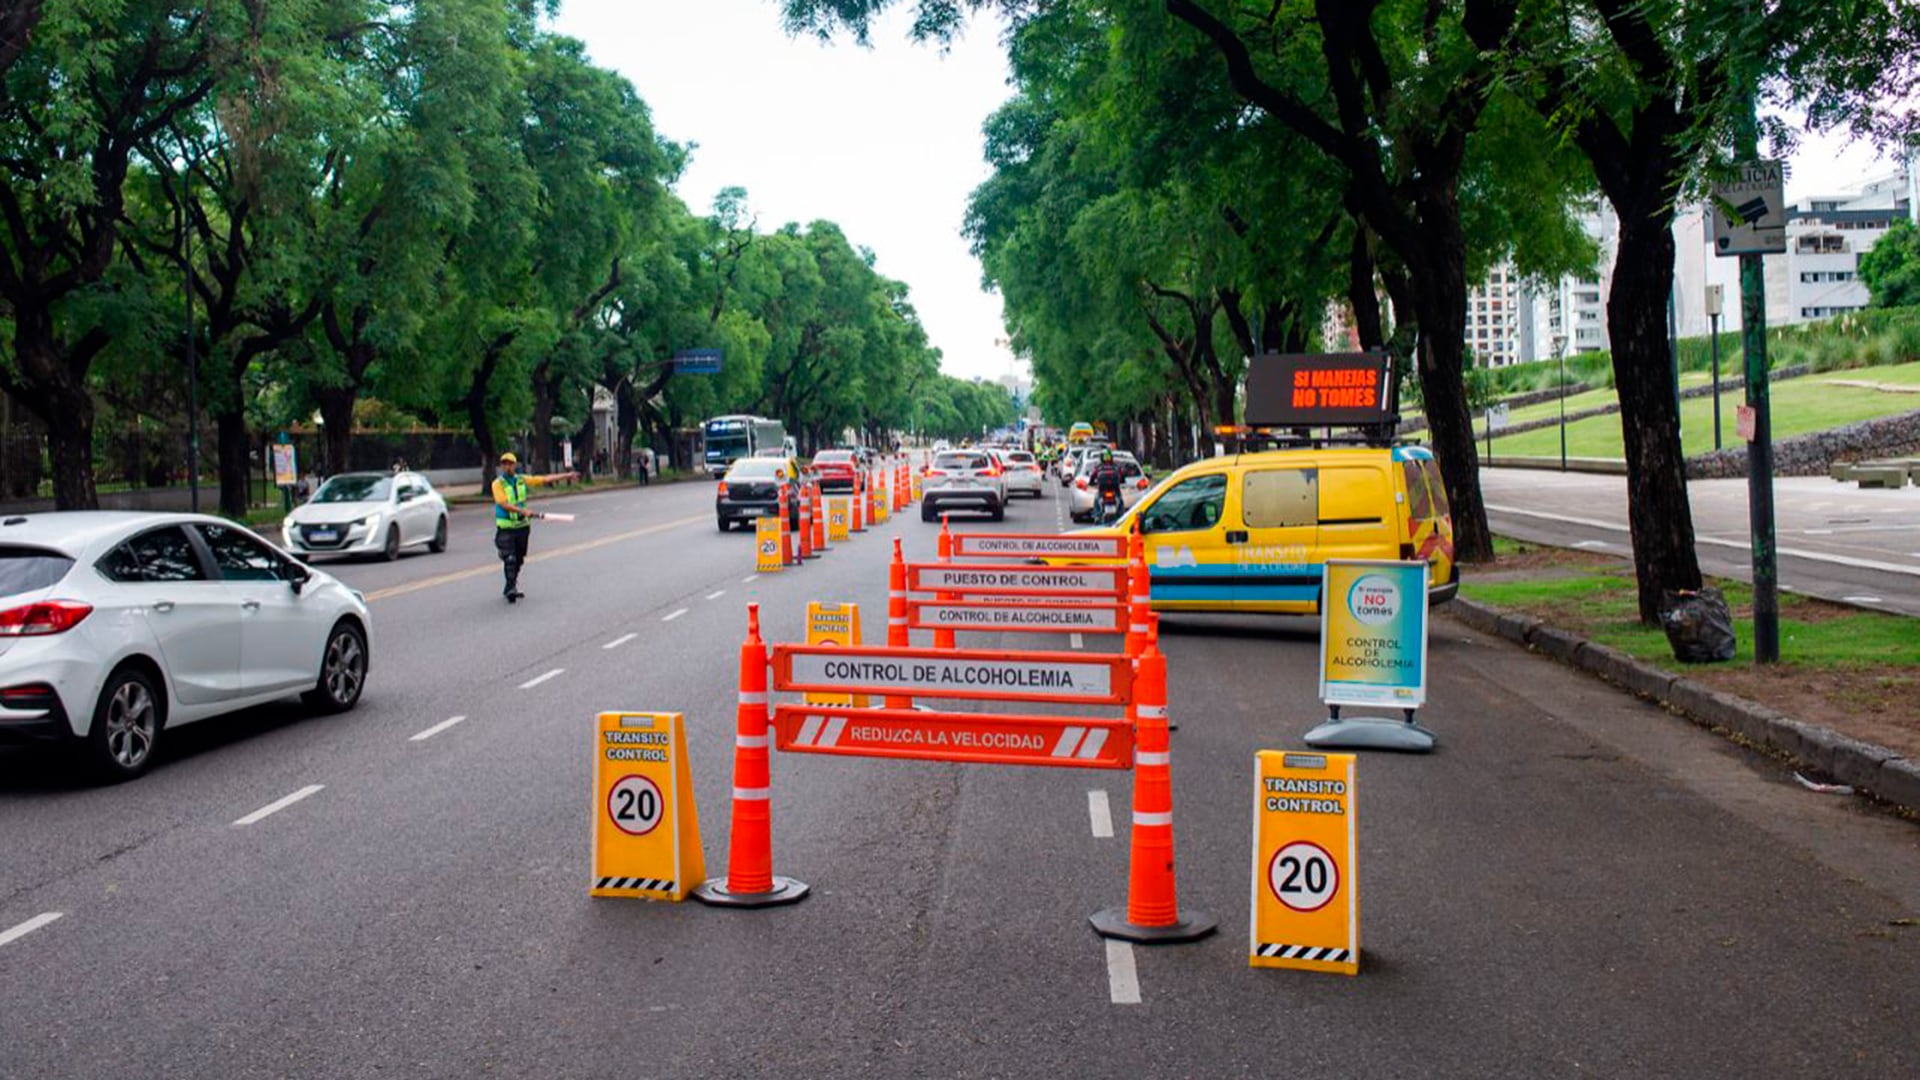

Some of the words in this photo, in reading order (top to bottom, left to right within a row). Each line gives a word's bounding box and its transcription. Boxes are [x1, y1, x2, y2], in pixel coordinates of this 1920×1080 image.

[1293, 371, 1310, 387] SI
[1292, 389, 1317, 408] NO
[1319, 388, 1376, 408] TOMES
[979, 540, 1020, 550] CONTROL
[1022, 541, 1034, 551] DE
[1036, 541, 1100, 551] ALCOHOLEMIA
[944, 572, 997, 585] PUESTO
[999, 574, 1018, 586] DE
[1021, 575, 1087, 587] CONTROL
[1364, 594, 1386, 606] NO
[939, 610, 992, 623] CONTROL
[994, 612, 1008, 623] DE
[1011, 612, 1094, 625] ALCOHOLEMIA
[1357, 606, 1393, 617] tomes
[1346, 638, 1402, 649] CONTROL
[1364, 648, 1379, 658] DE
[1332, 656, 1414, 669] ALCOHOLEMIA
[824, 661, 908, 681] CONTROL
[912, 665, 937, 683] DE
[941, 666, 1074, 688] ALCOHOLEMIA
[605, 731, 669, 745] TRANSITO
[850, 726, 924, 743] REDUZCA
[927, 730, 948, 745] LA
[951, 731, 1045, 750] VELOCIDAD
[606, 747, 669, 762] CONTROL
[1264, 777, 1346, 795] TRANSITO
[617, 788, 655, 821] 20
[1266, 796, 1345, 815] CONTROL
[1279, 856, 1328, 893] 20
